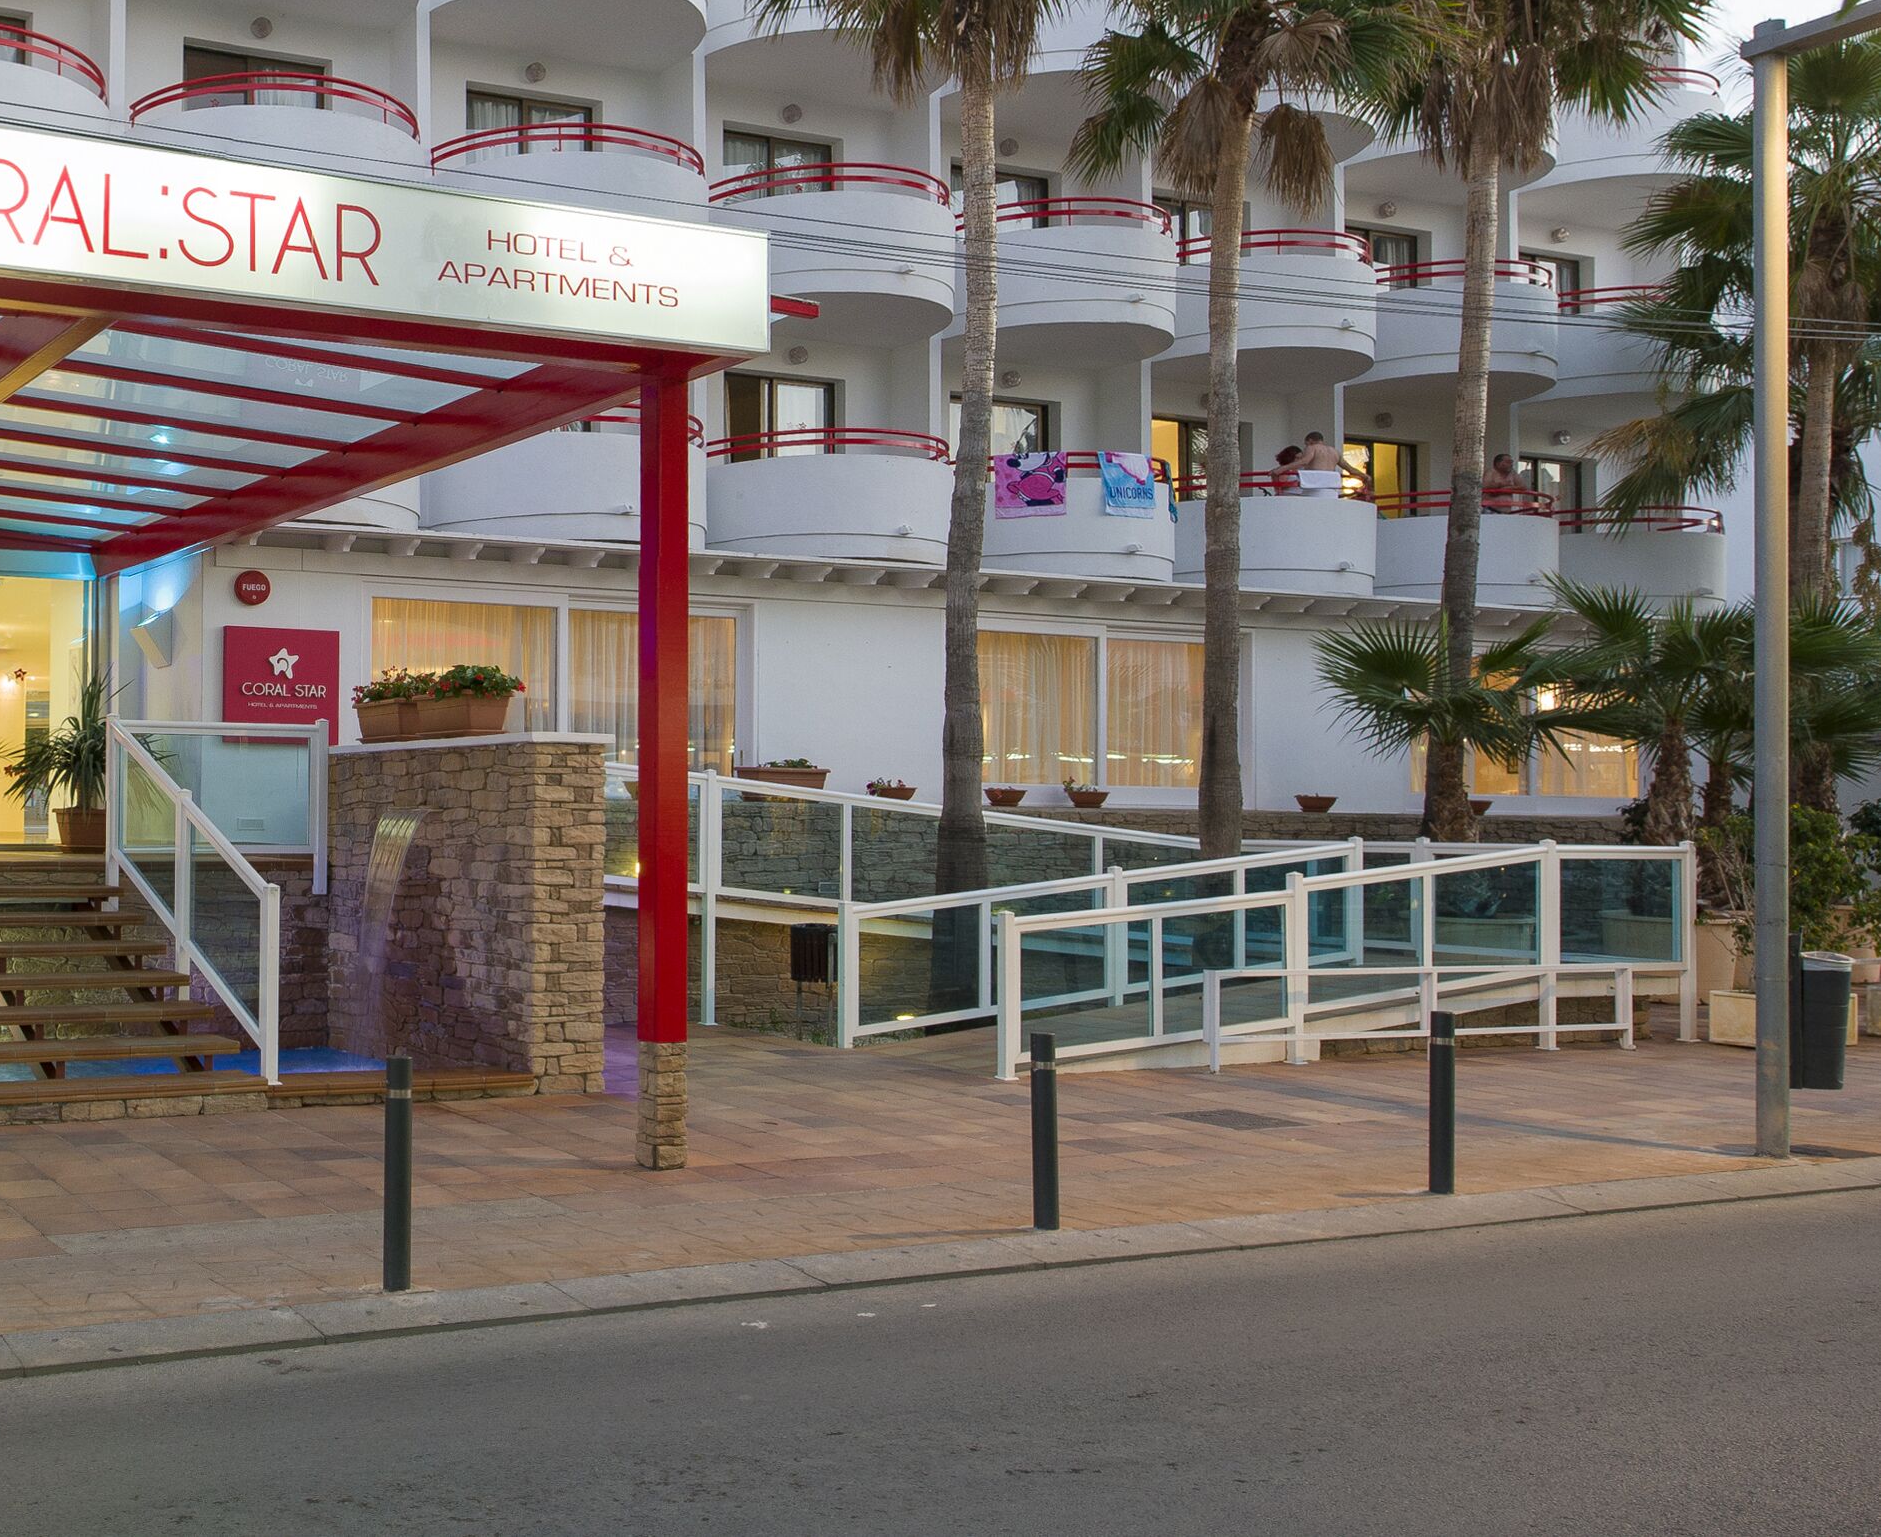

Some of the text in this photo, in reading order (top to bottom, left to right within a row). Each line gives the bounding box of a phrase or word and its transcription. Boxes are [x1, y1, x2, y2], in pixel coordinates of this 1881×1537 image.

[487, 229, 634, 268] HOTEL &
[437, 260, 680, 308] APARTMENTS
[1110, 486, 1153, 500] UNICORNS
[242, 583, 266, 591] FUEGO
[241, 681, 327, 699] CORAL STAR
[275, 702, 318, 710] APARTMENTS
